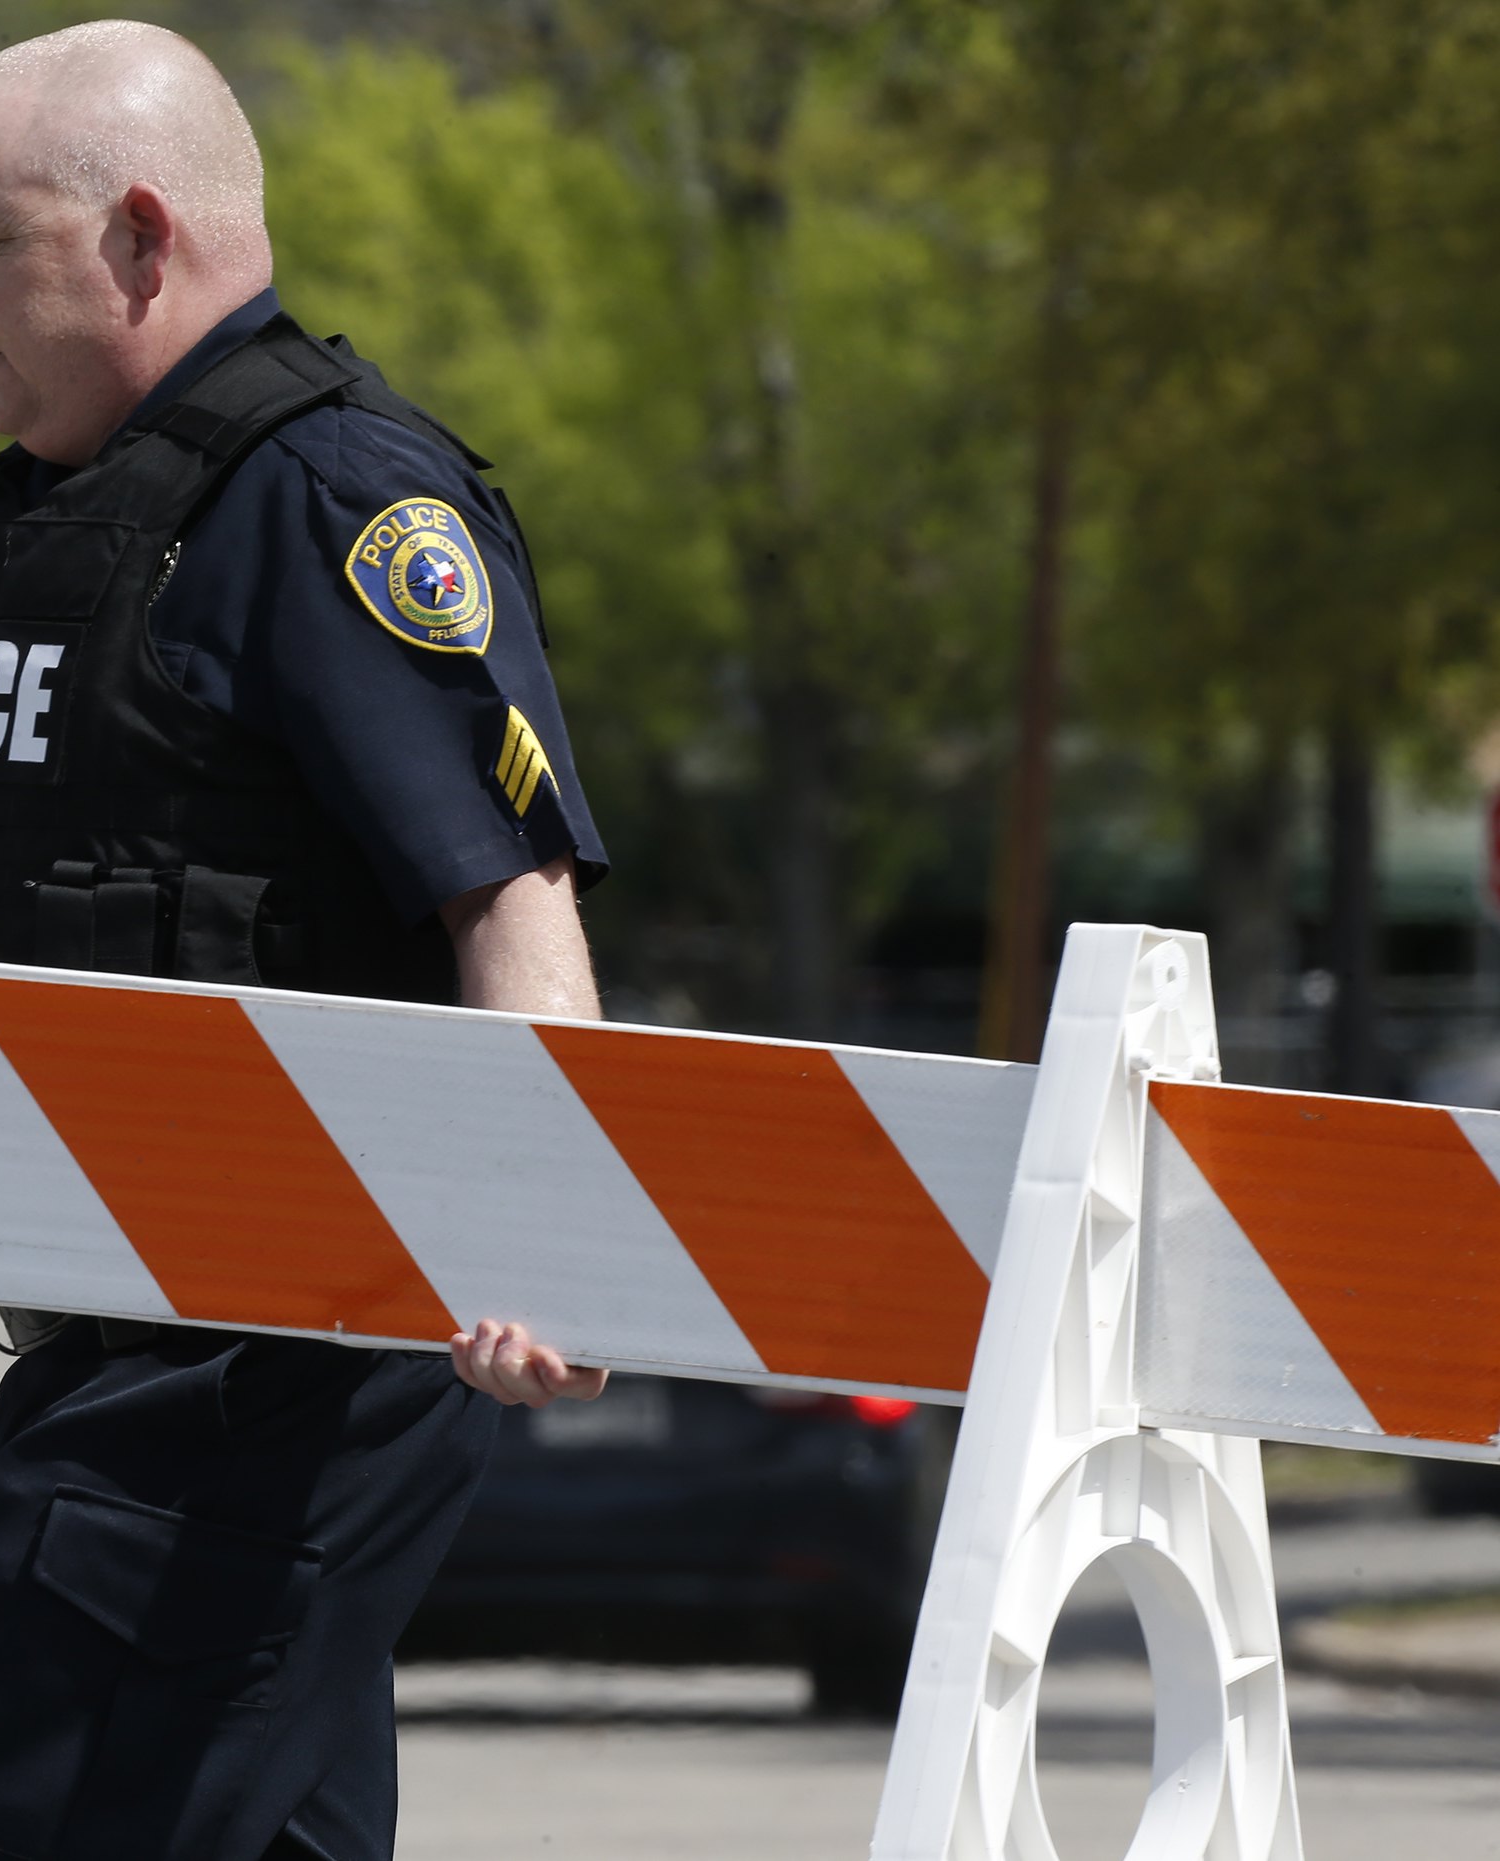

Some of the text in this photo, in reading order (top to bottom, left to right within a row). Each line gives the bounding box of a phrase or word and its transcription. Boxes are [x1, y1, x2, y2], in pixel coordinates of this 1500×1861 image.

[360, 507, 450, 569] POLICE
[392, 562, 404, 601] STATE
[407, 538, 424, 551] OF
